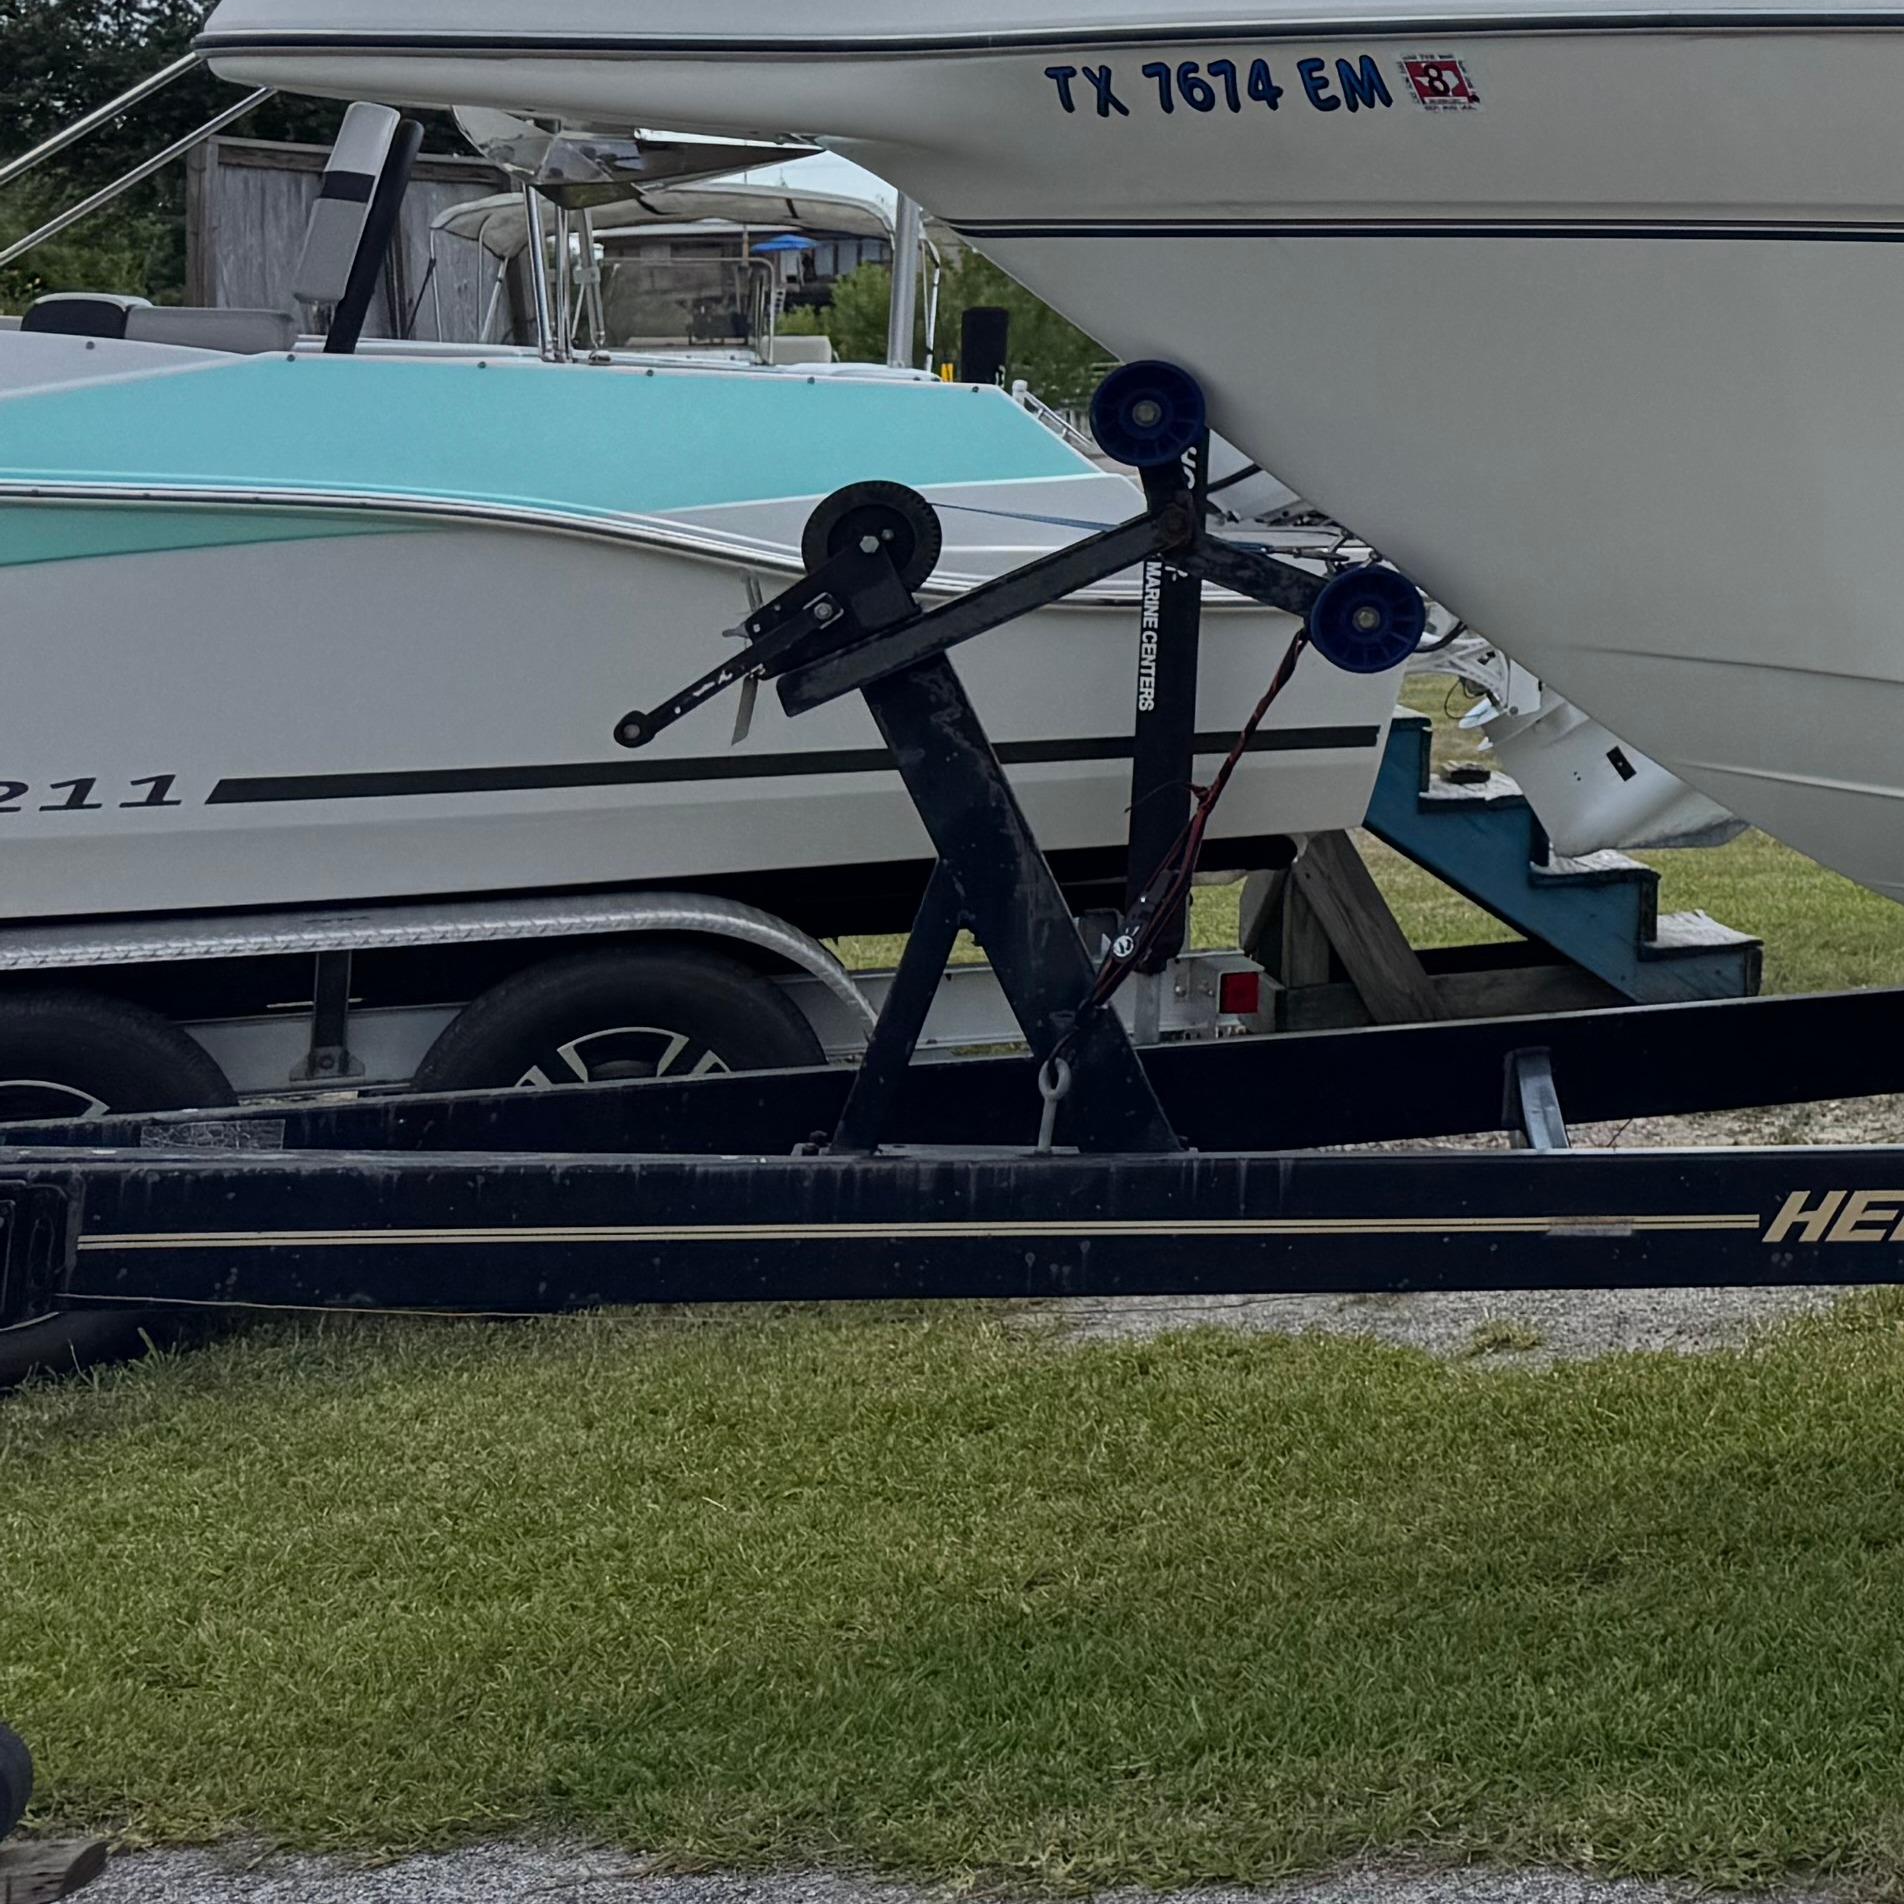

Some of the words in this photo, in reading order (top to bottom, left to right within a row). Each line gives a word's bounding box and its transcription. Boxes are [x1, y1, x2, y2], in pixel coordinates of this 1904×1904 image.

[1044, 64, 1130, 118] TX
[1142, 57, 1284, 115] 7674
[1297, 54, 1394, 113] EM
[1143, 561, 1162, 628] MARINE
[1138, 630, 1158, 712] CENTERS
